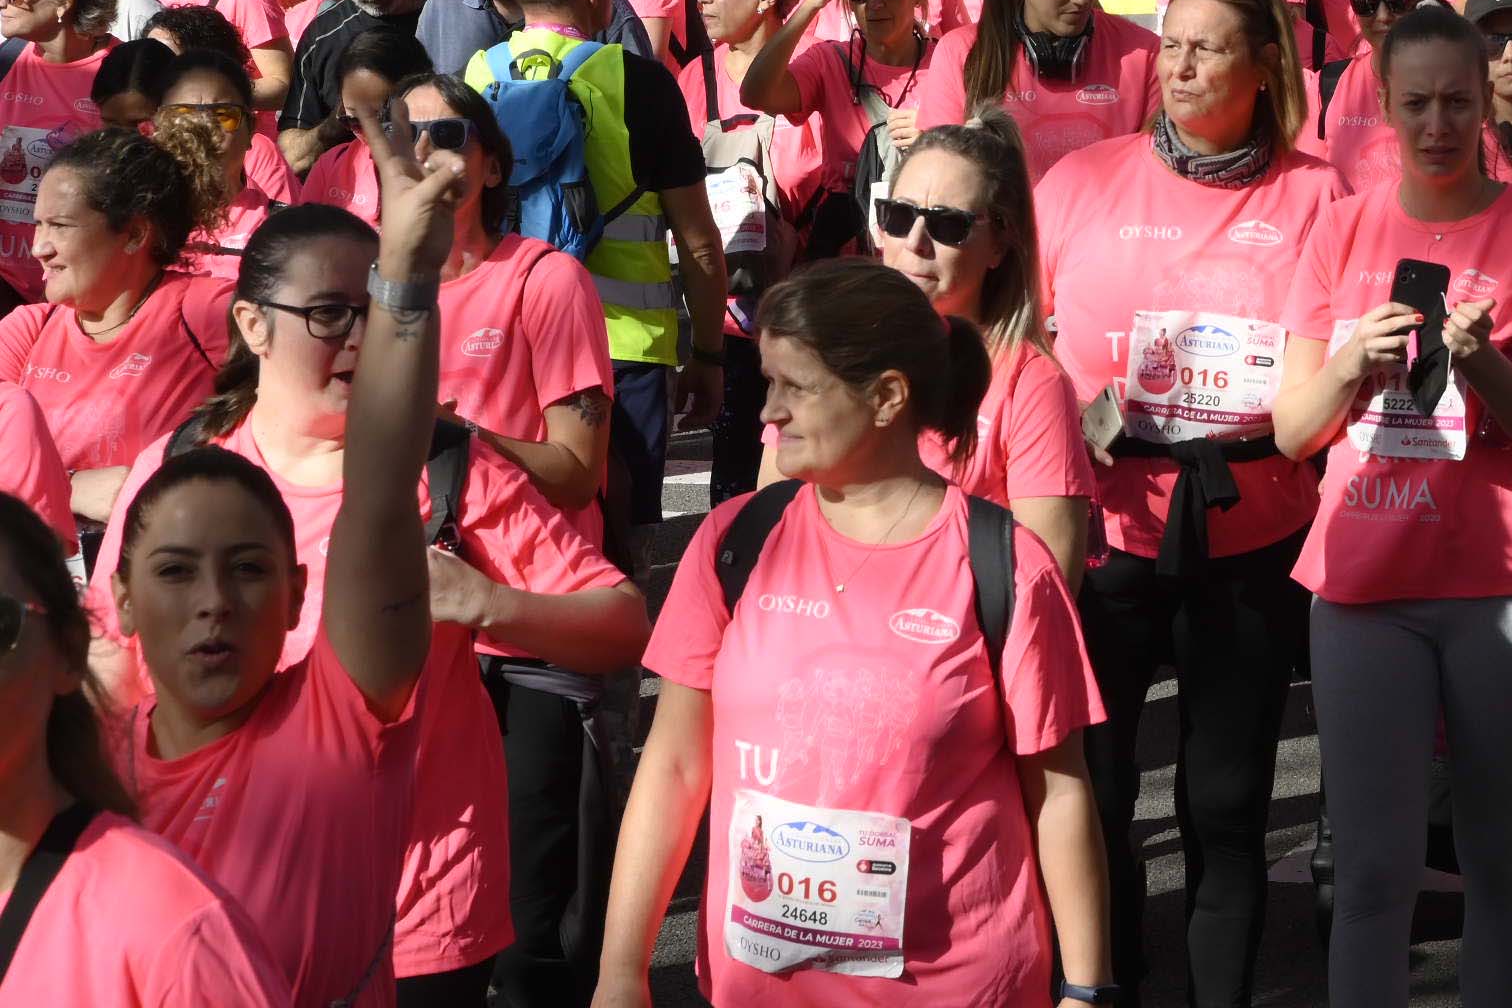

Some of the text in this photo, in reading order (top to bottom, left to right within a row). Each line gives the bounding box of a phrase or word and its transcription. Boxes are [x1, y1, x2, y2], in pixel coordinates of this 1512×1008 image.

[1119, 225, 1183, 241] OYSHO
[1233, 229, 1279, 242] ASTURIANA
[1180, 334, 1235, 351] ASTURIANA
[1180, 366, 1229, 389] 016
[1183, 392, 1221, 407] 25220
[1196, 411, 1208, 420] LA
[1209, 414, 1240, 423] MUJER
[1344, 476, 1438, 510] SUMA
[758, 593, 830, 619] OYSHO
[896, 619, 955, 638] ASTURIANA
[735, 739, 780, 786] TU
[776, 831, 843, 857] ASTURIANA
[858, 836, 896, 848] SUMA
[777, 872, 838, 903] 016
[782, 904, 828, 926] 24648
[743, 915, 883, 949] CARRERA DE LA MUJER 2023
[740, 935, 781, 962] OYSHO
